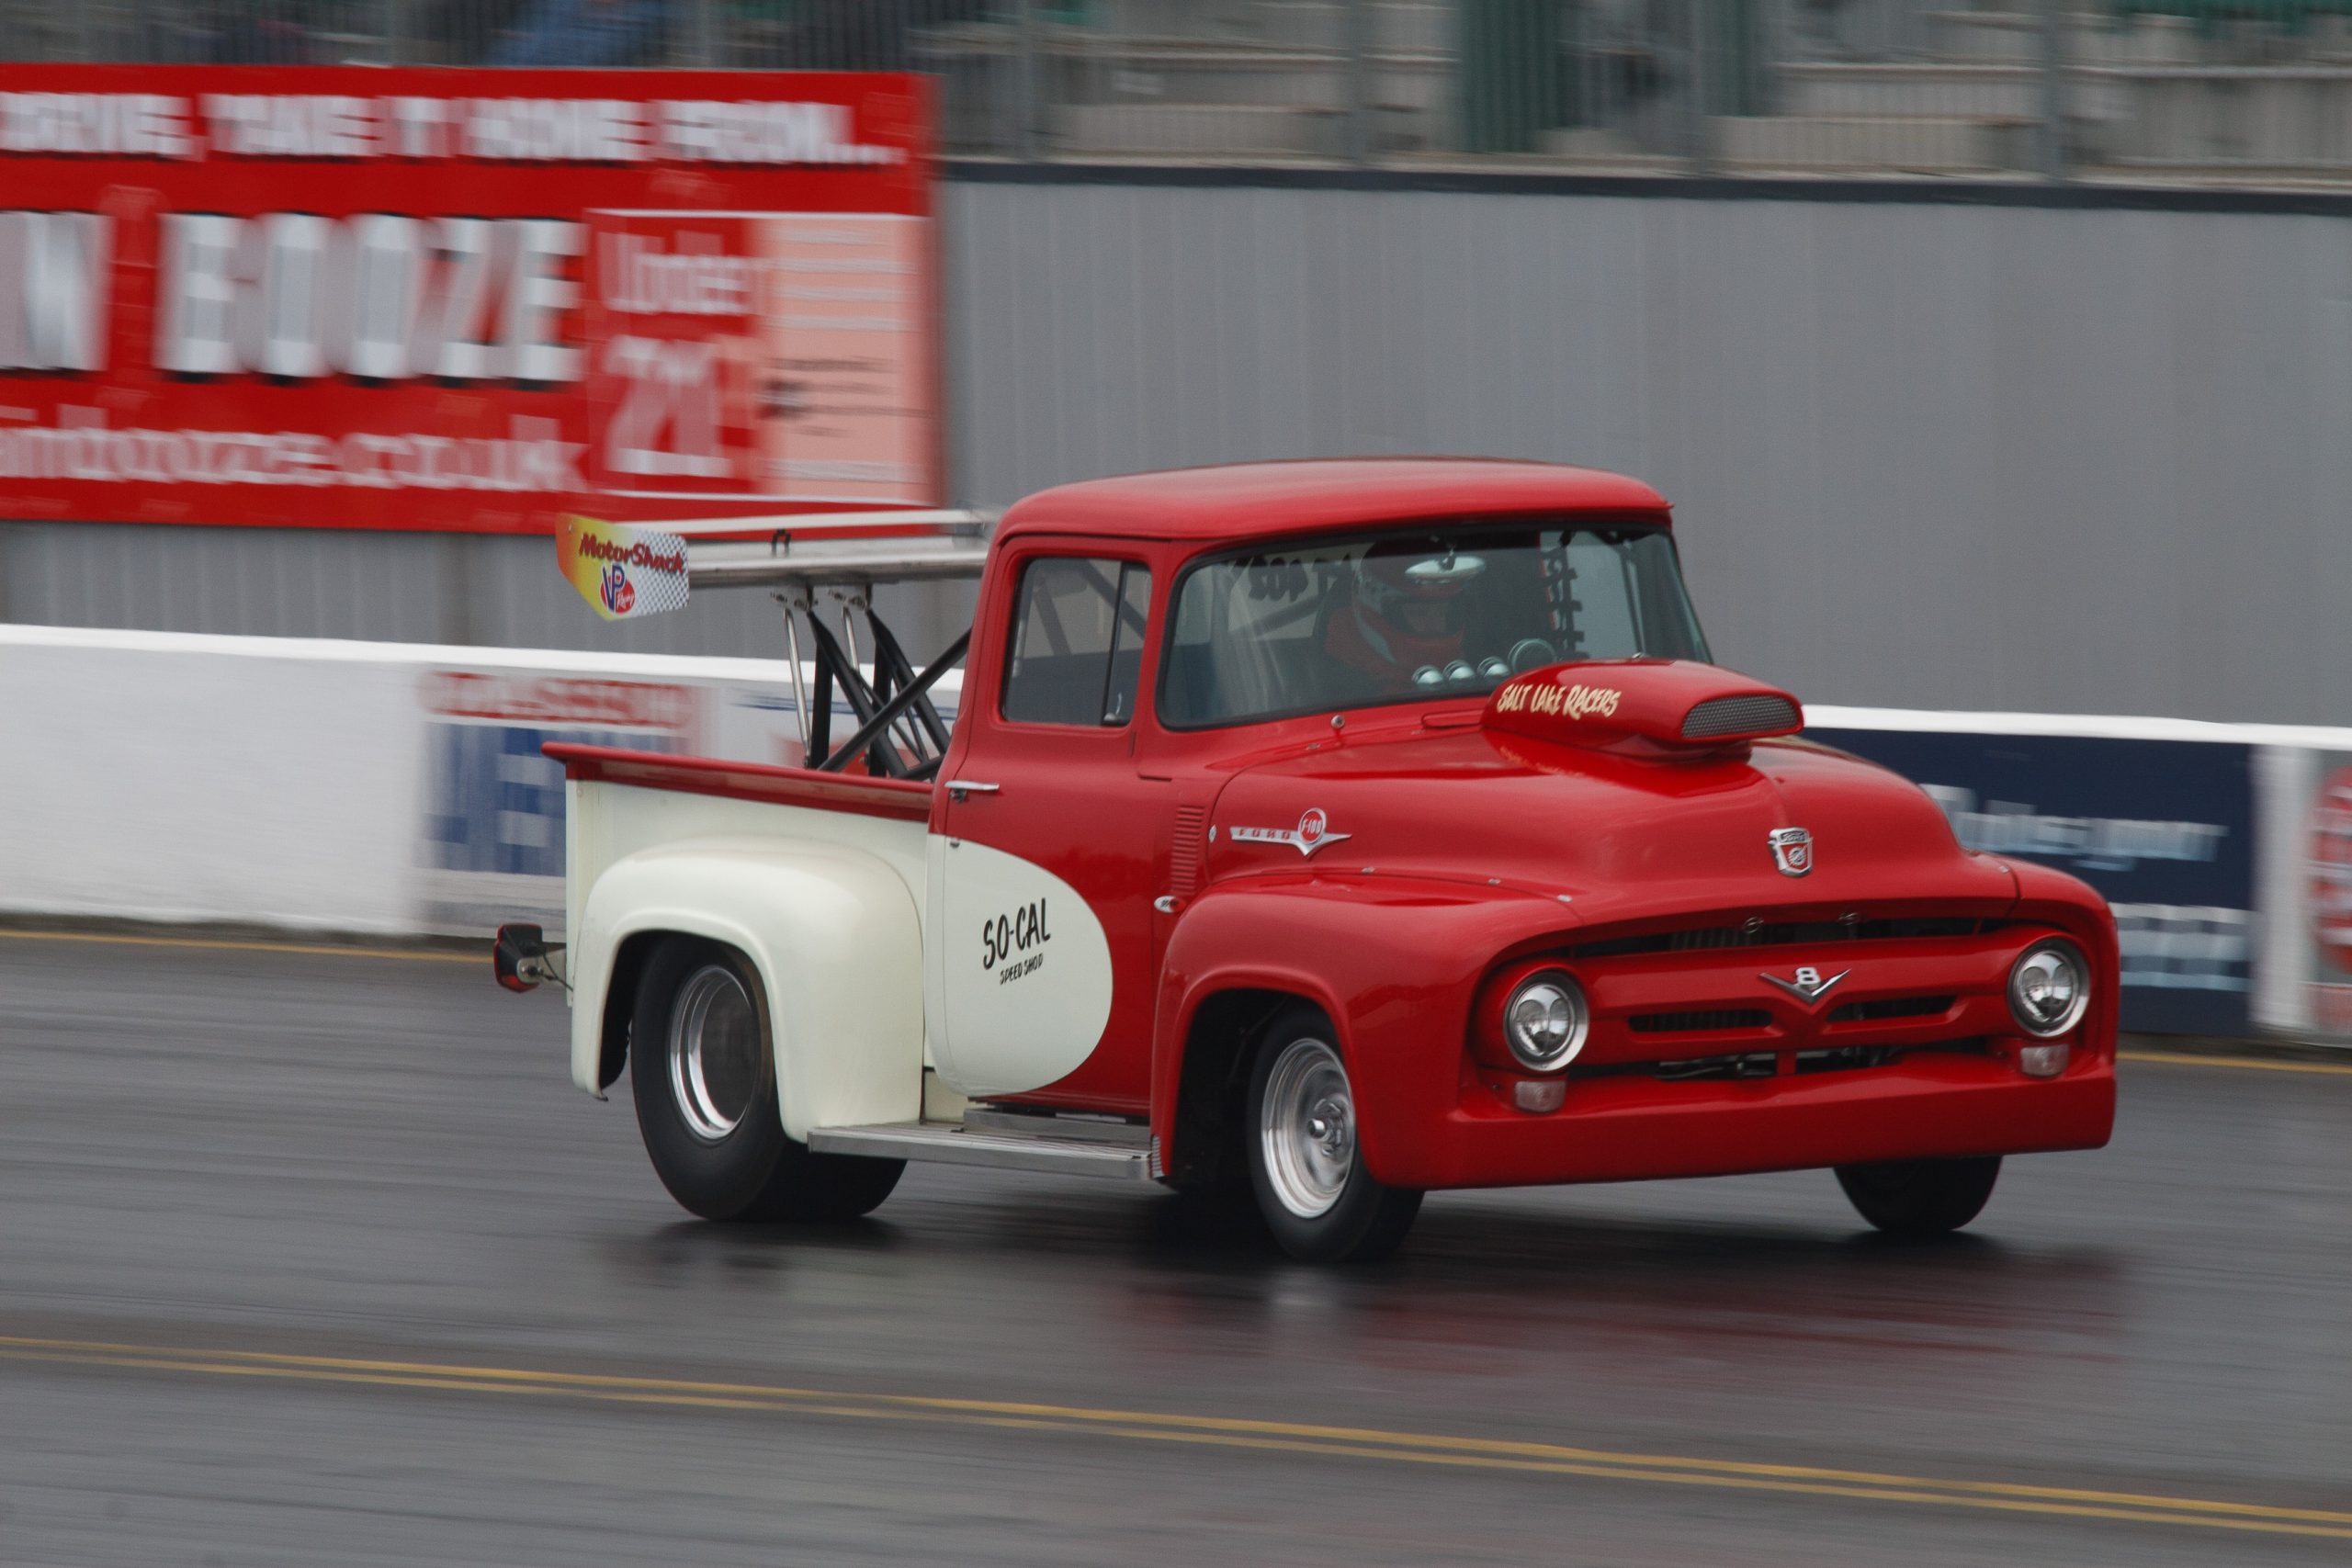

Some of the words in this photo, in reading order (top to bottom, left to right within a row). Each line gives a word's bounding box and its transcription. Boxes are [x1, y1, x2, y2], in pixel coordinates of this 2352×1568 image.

[150, 210, 590, 382] BOOZE
[579, 533, 684, 574] MotorShack
[602, 563, 627, 613] VP
[1497, 683, 1533, 713] SALT
[1530, 683, 1567, 716] LAKE
[1562, 684, 1622, 720] RACERS
[1238, 828, 1291, 840] FORD
[982, 897, 1051, 970] SO-CAL
[1000, 962, 1023, 986] SPEED
[1023, 953, 1044, 976] SHOP
